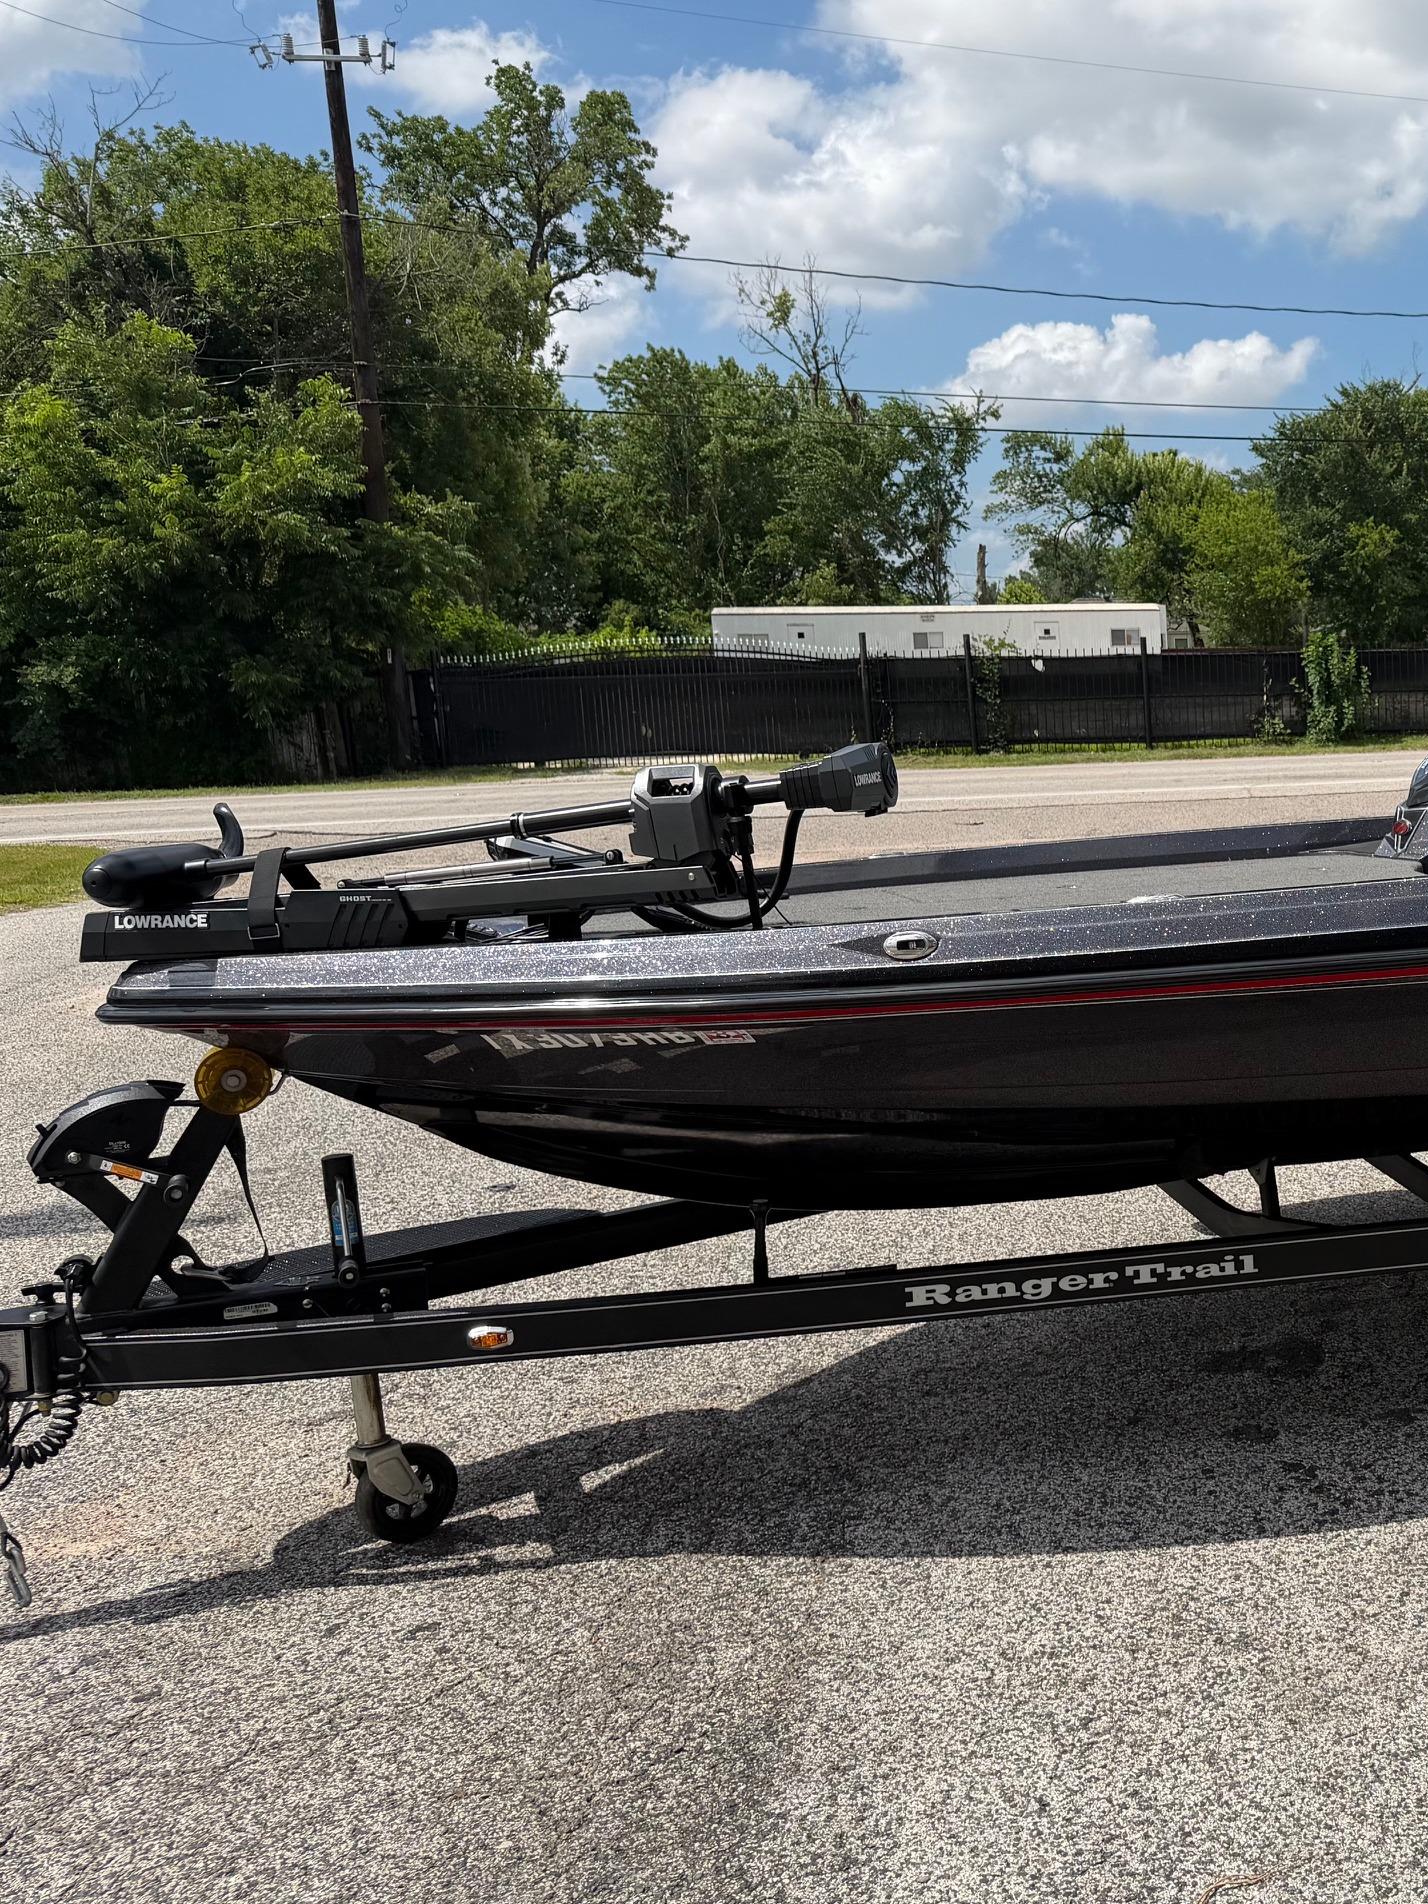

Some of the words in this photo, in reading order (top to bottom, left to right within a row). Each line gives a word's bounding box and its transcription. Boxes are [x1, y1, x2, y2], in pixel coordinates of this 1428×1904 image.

[853, 770, 882, 787] LOWRANCE
[114, 912, 208, 930] LOWRANCE
[904, 1270, 1119, 1307] Ranger
[1124, 1254, 1260, 1286] Trail
